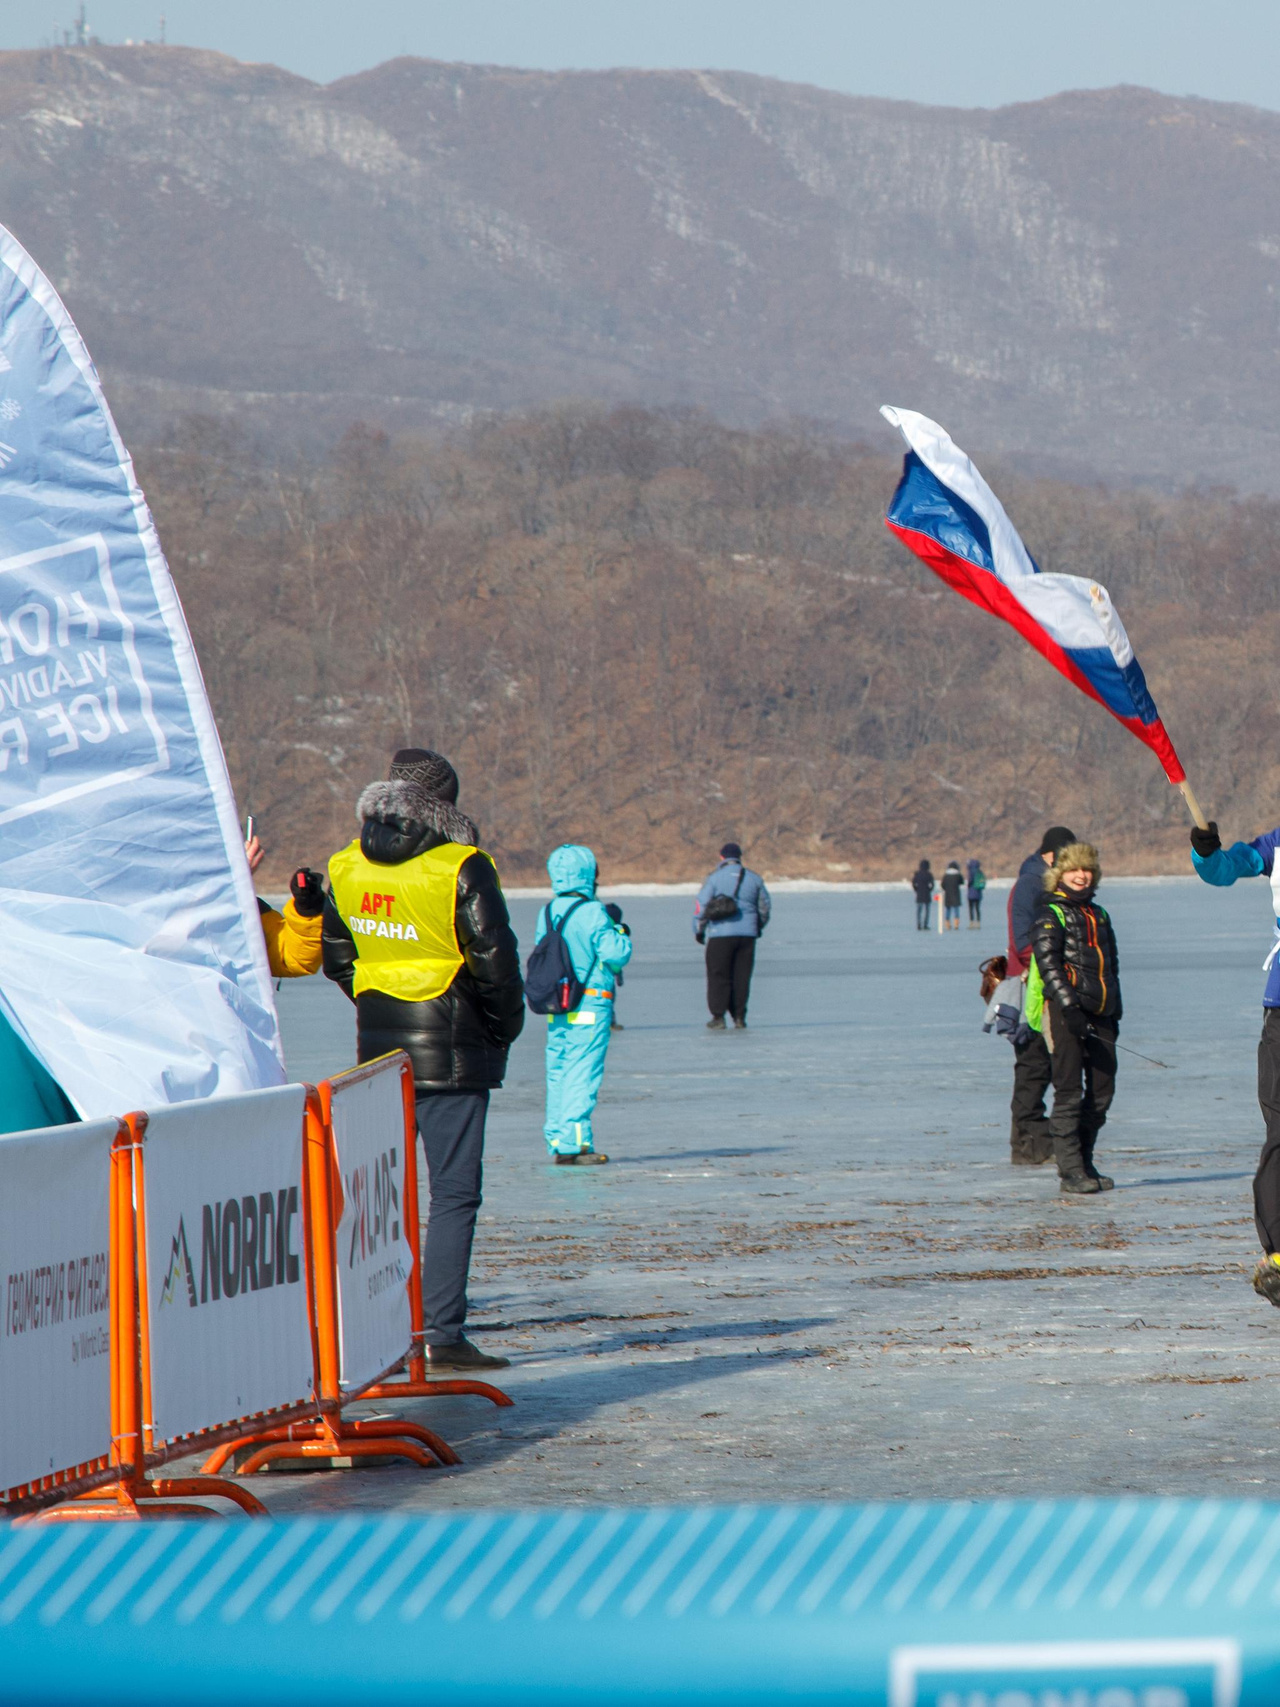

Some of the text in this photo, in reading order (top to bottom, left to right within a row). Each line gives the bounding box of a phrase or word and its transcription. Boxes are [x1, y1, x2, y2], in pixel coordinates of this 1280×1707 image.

[360, 892, 395, 917] АРТ
[350, 915, 420, 941] ОХРАНА
[201, 1186, 300, 1304] NORDIC
